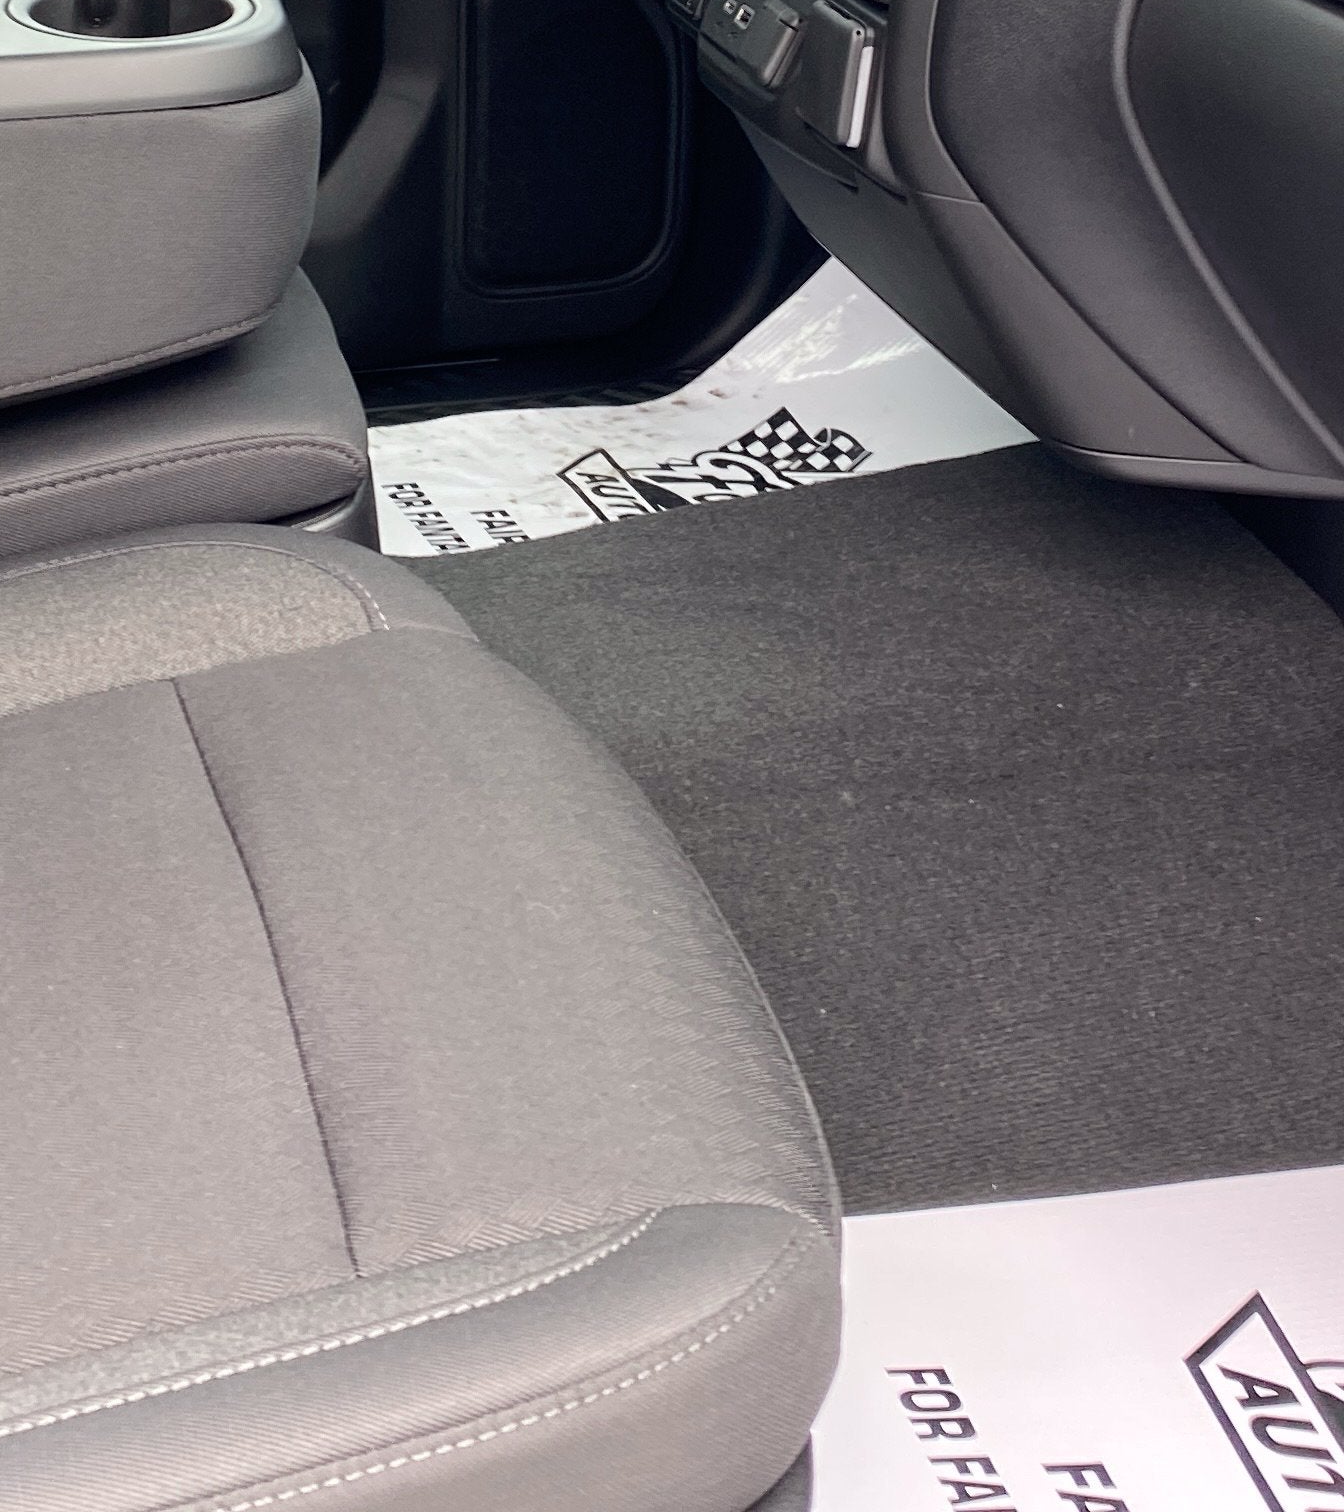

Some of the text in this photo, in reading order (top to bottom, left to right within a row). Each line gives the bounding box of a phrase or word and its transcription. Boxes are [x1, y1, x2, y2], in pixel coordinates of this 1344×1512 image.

[381, 483, 433, 507] FOR
[574, 472, 650, 519] AUT
[884, 1367, 1018, 1512] FOR FA
